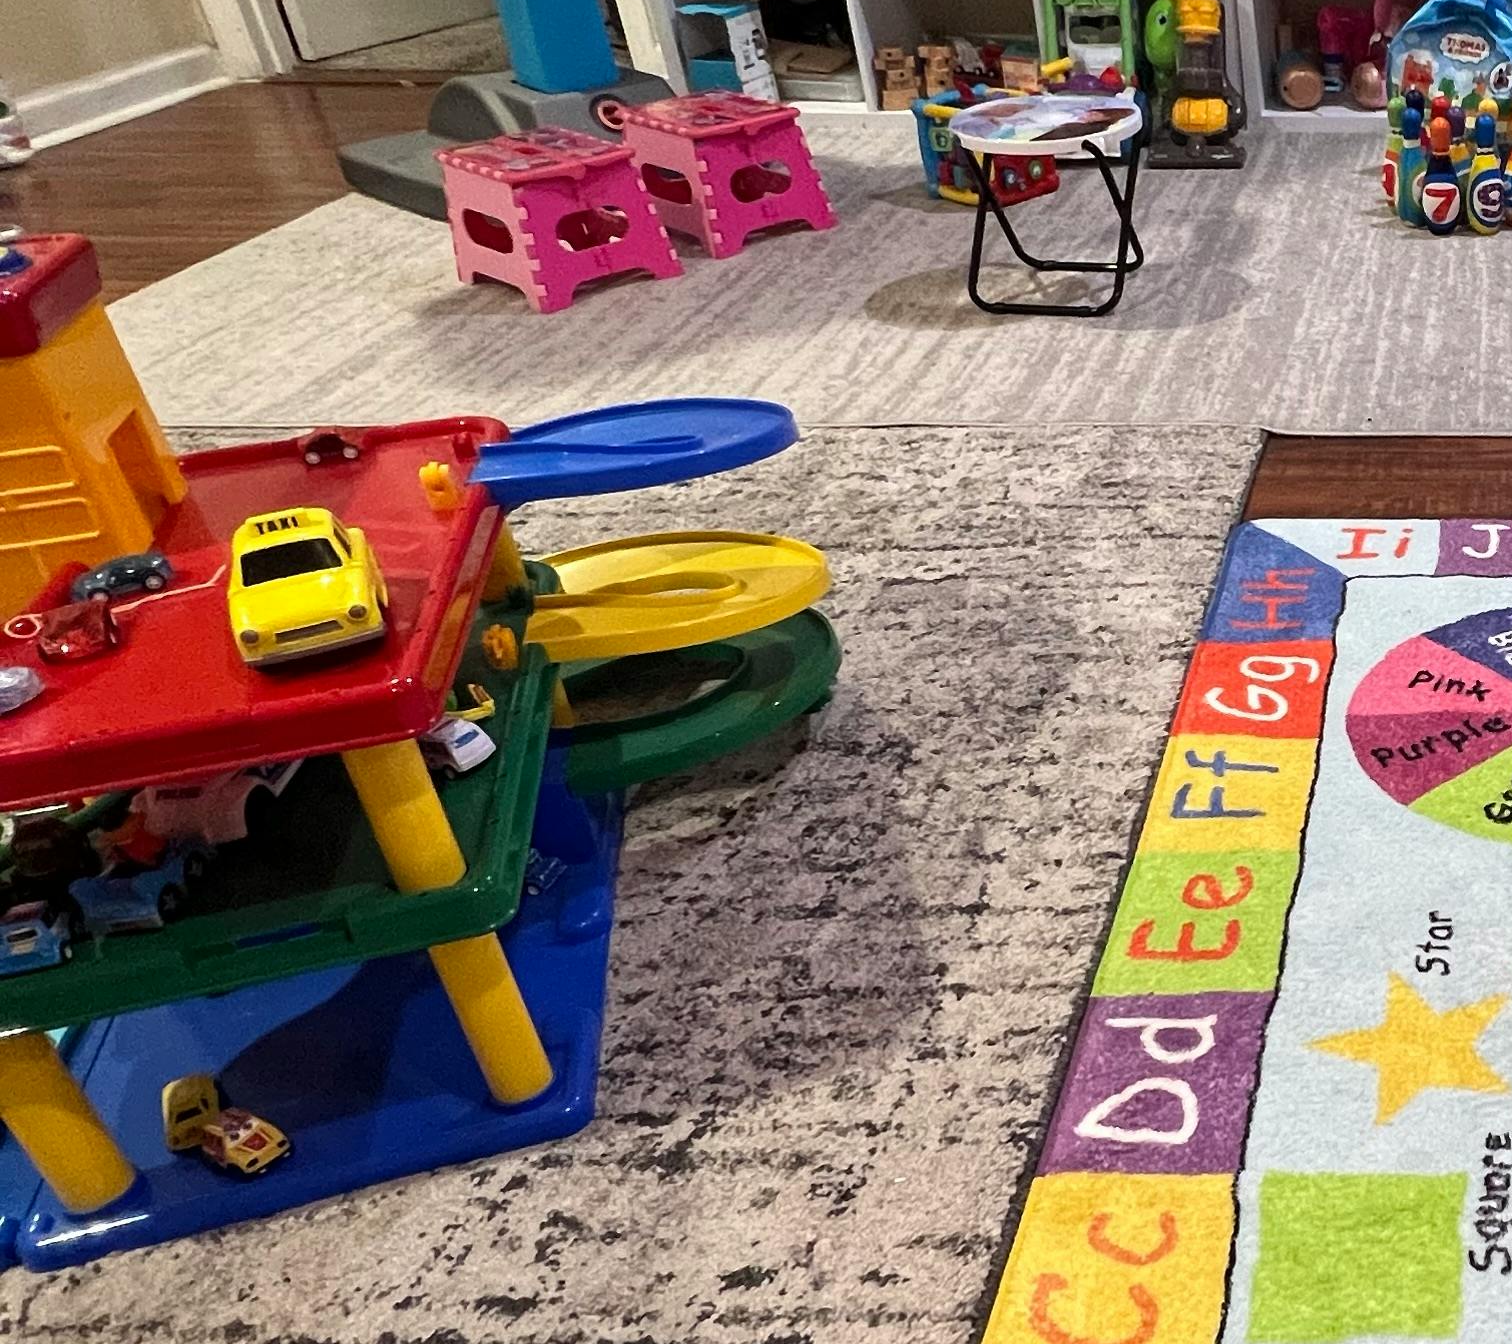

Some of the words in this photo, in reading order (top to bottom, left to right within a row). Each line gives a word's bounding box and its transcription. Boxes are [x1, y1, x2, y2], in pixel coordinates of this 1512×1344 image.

[1425, 188, 1457, 221] 7
[1477, 182, 1504, 218] 9
[255, 515, 299, 535] TAXI
[1336, 527, 1416, 560] Ii
[1231, 568, 1316, 630] Hh
[1204, 655, 1320, 721] Gg
[1408, 669, 1493, 702] Pink
[1370, 714, 1512, 769] Purple
[1169, 749, 1280, 821] Ff
[1126, 865, 1254, 963] Ee
[1414, 909, 1456, 977] Star
[1073, 1014, 1219, 1145] Dd
